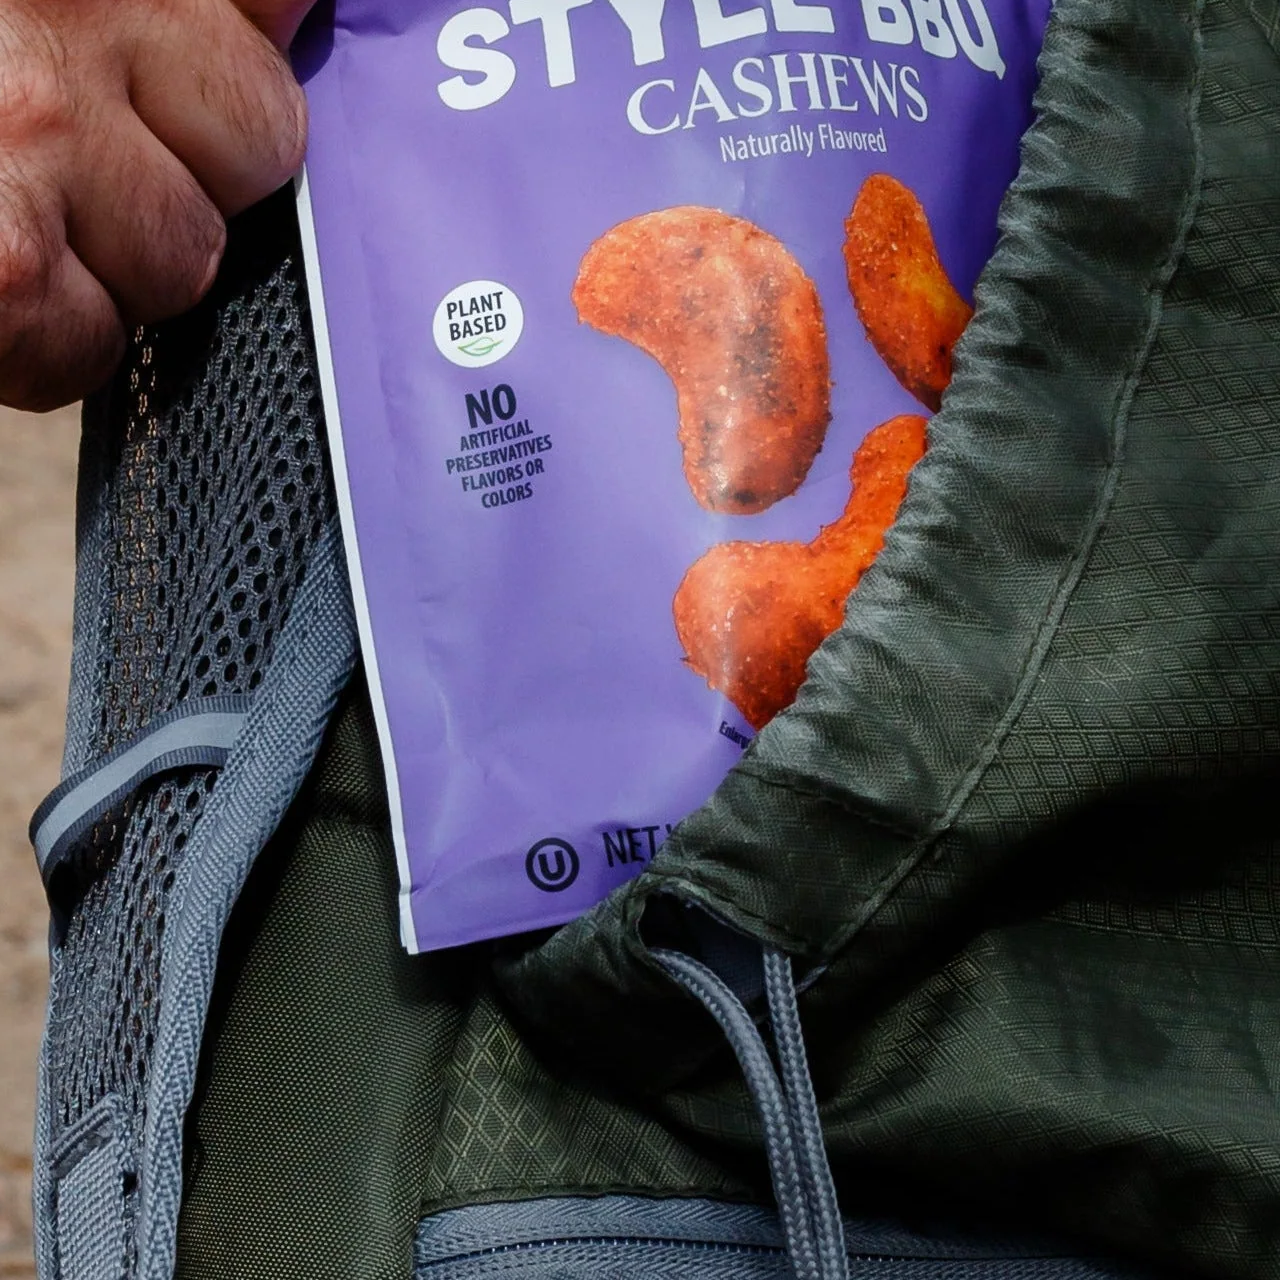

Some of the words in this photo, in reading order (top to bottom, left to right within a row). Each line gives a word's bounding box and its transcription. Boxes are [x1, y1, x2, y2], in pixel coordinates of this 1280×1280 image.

[626, 53, 929, 135] CASHEWS
[720, 124, 814, 163] Naturally
[818, 123, 887, 154] Flavored
[446, 291, 504, 320] PLANT
[449, 313, 507, 341] BASED
[465, 383, 517, 429] NO
[460, 419, 533, 452] ARTIFICIAL
[446, 434, 552, 475] PRESERVATIVES
[461, 464, 523, 492] FLAVORS
[526, 458, 545, 477] OR
[481, 482, 533, 508] COLORS
[602, 824, 660, 868] NET
